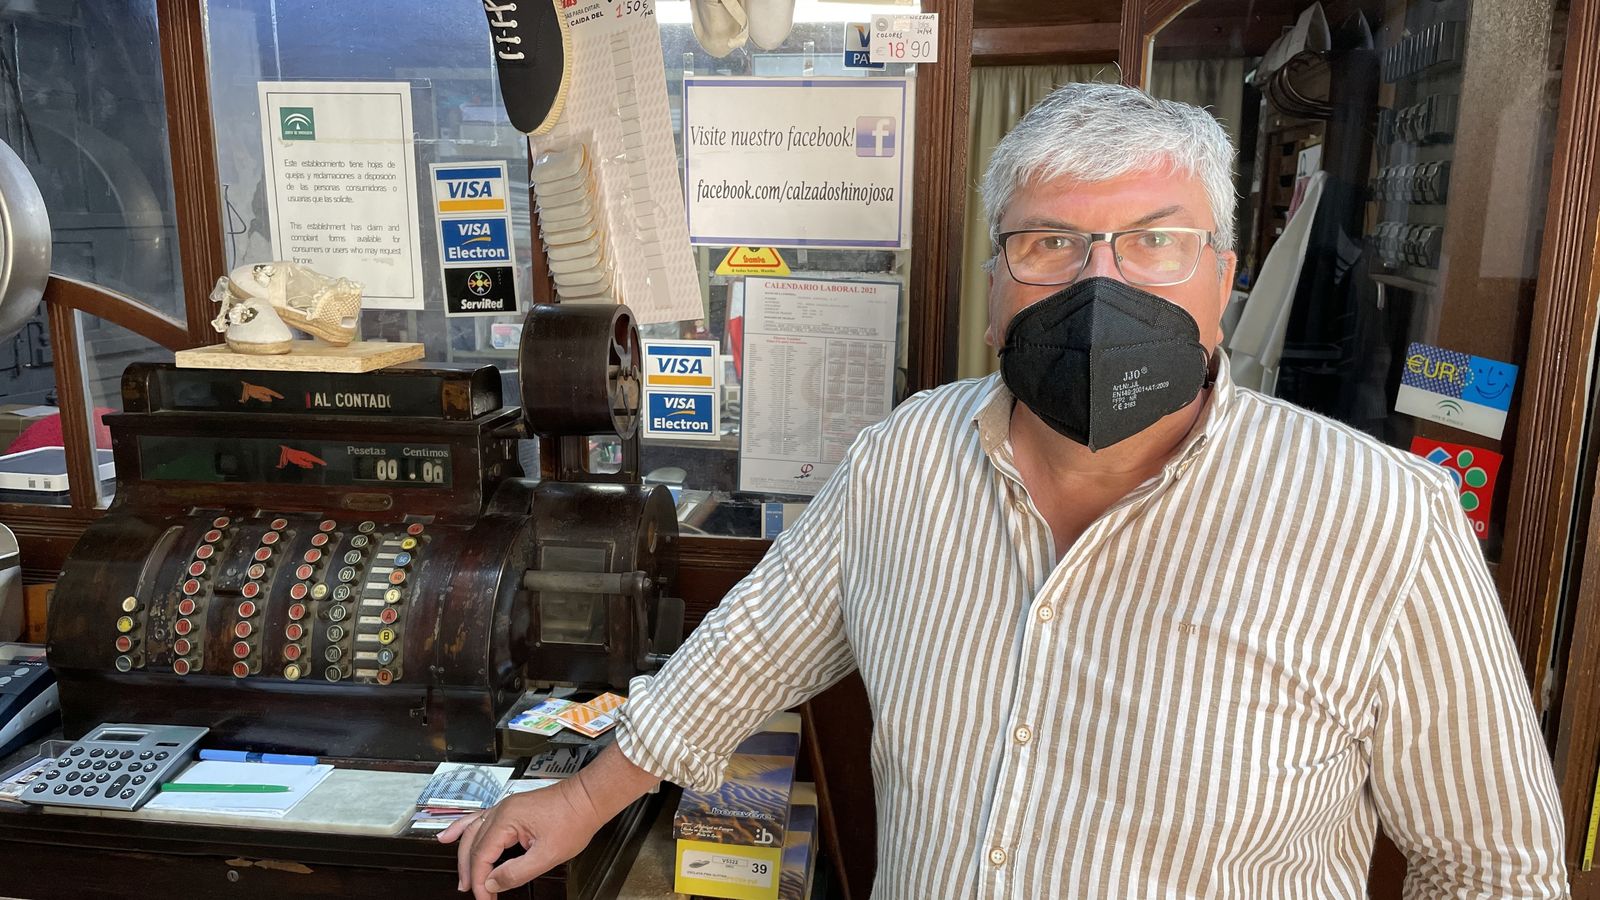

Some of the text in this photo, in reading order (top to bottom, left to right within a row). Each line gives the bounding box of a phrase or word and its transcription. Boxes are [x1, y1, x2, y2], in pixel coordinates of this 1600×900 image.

[591, 11, 604, 19] DEL
[853, 53, 872, 64] PA
[690, 126, 856, 151] Visite nuestro facebook!
[284, 159, 297, 167] Este
[367, 161, 383, 169] hojas
[447, 181, 492, 198] VISA
[697, 180, 894, 206] facebook.com/calzadoshinojosa
[290, 222, 302, 230] This
[351, 223, 362, 231] has
[457, 223, 491, 236] VISA
[448, 247, 505, 259] Electron
[764, 281, 818, 291] CALENDARIO
[820, 284, 860, 293] LABORAL
[461, 298, 503, 310] ServiRed
[657, 358, 702, 374] VISA
[314, 392, 331, 407] AL
[664, 397, 695, 409] VISA
[654, 418, 708, 430] Electron
[347, 446, 386, 456] Pesetas
[337, 588, 347, 598] 50
[333, 608, 342, 619] 40
[331, 629, 339, 638] 30
[384, 632, 390, 640] B
[329, 649, 338, 659] 20
[382, 651, 389, 661] C
[329, 669, 337, 679] 10
[752, 863, 767, 874] 39
